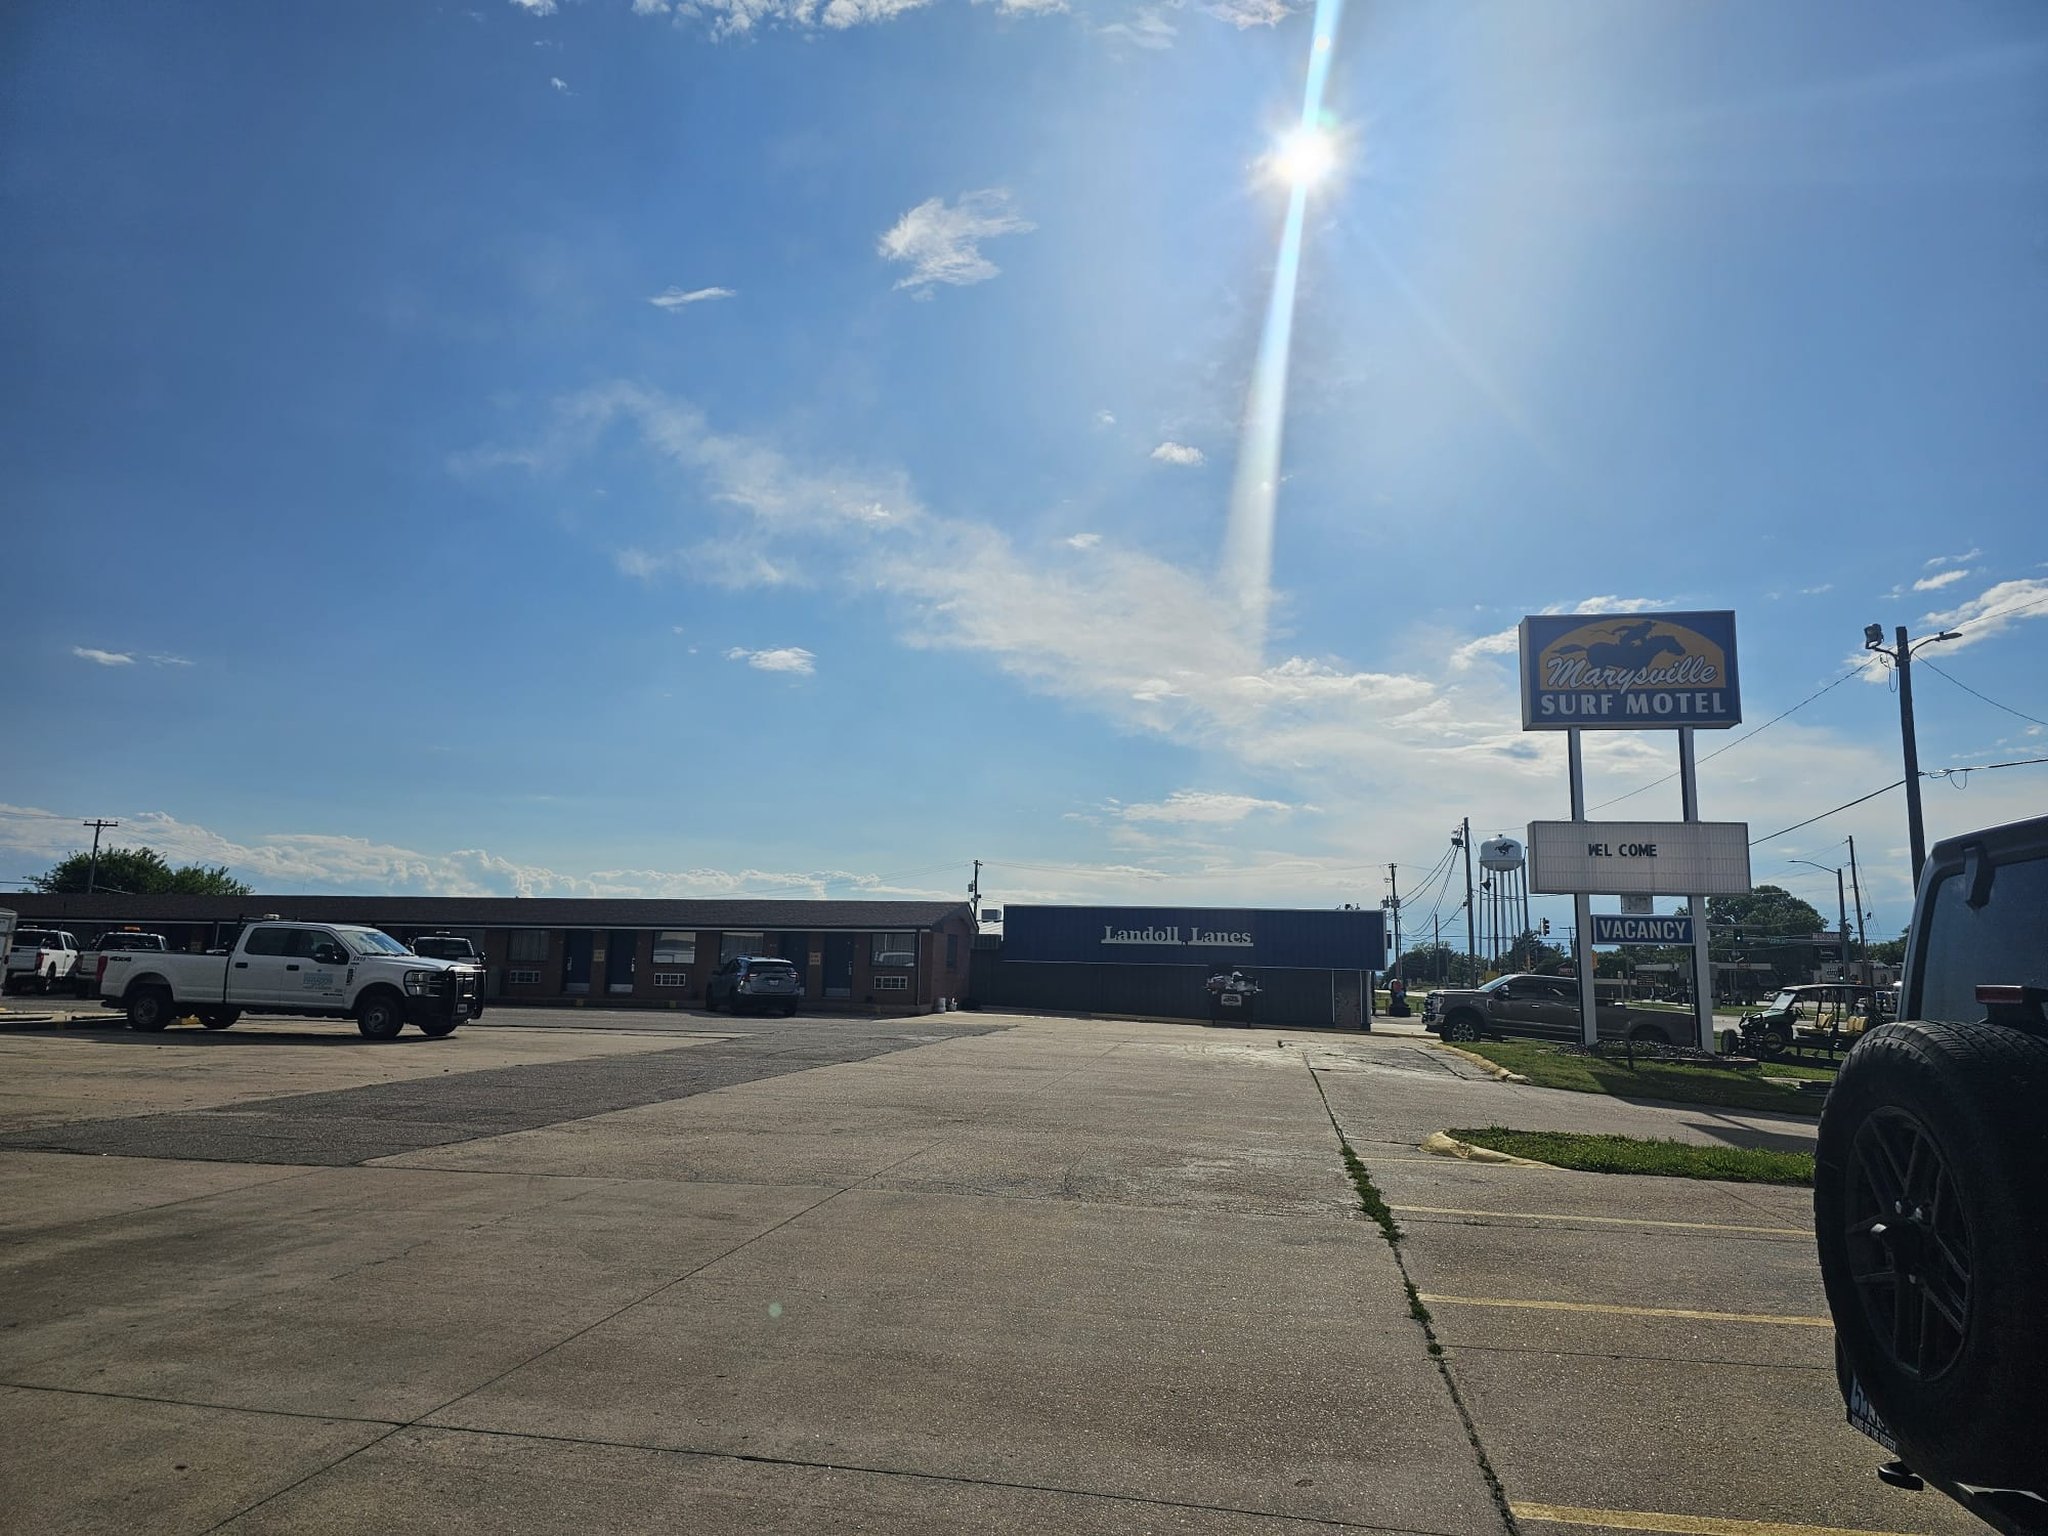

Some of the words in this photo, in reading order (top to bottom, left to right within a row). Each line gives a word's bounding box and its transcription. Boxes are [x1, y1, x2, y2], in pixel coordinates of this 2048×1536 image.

[1546, 655, 1718, 694] Marysville
[1541, 693, 1613, 715] SURF
[1626, 692, 1726, 714] MOTEL
[1104, 925, 1179, 943] Landoll
[1190, 927, 1252, 944] Lanes
[1600, 920, 1686, 940] VACANCY
